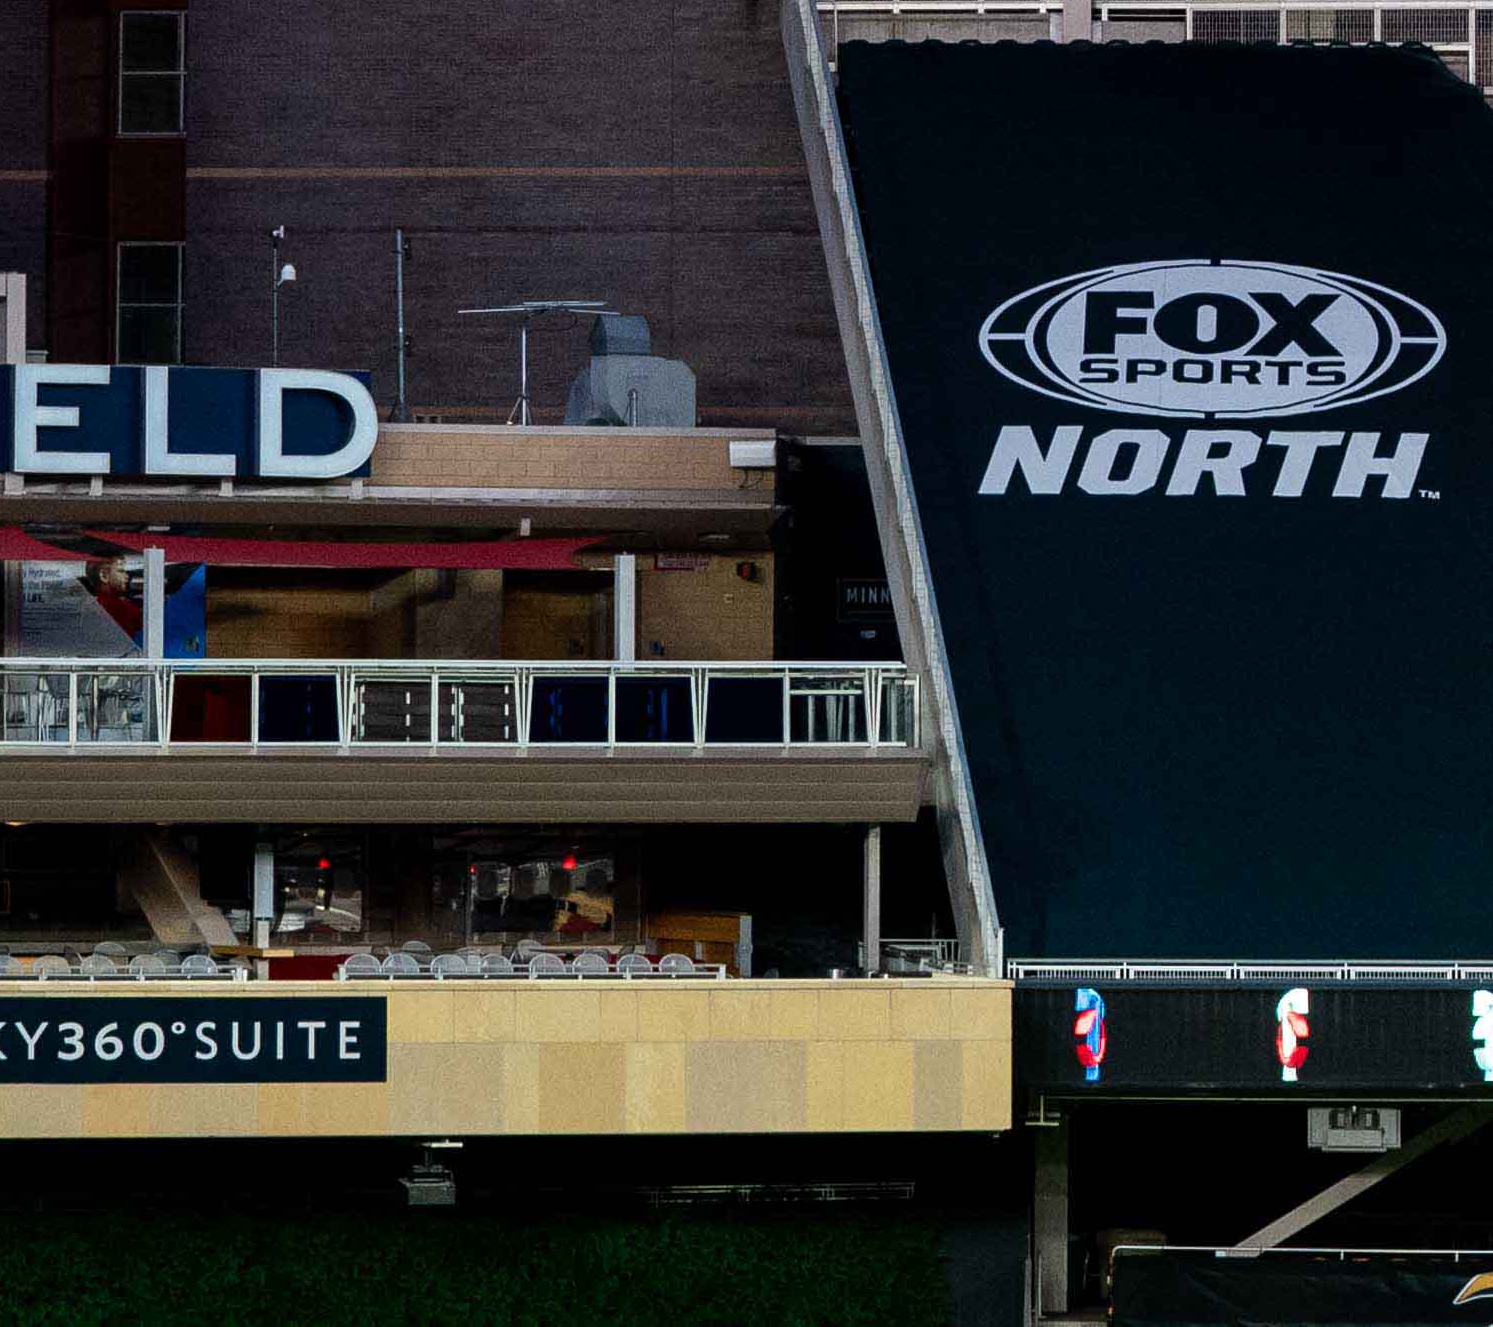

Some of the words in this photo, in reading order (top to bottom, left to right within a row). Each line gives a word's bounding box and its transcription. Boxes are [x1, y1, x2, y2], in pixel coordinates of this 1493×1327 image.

[1083, 290, 1343, 358] FOX
[1079, 356, 1348, 387] SPORTS
[978, 424, 1430, 500] NORTH
